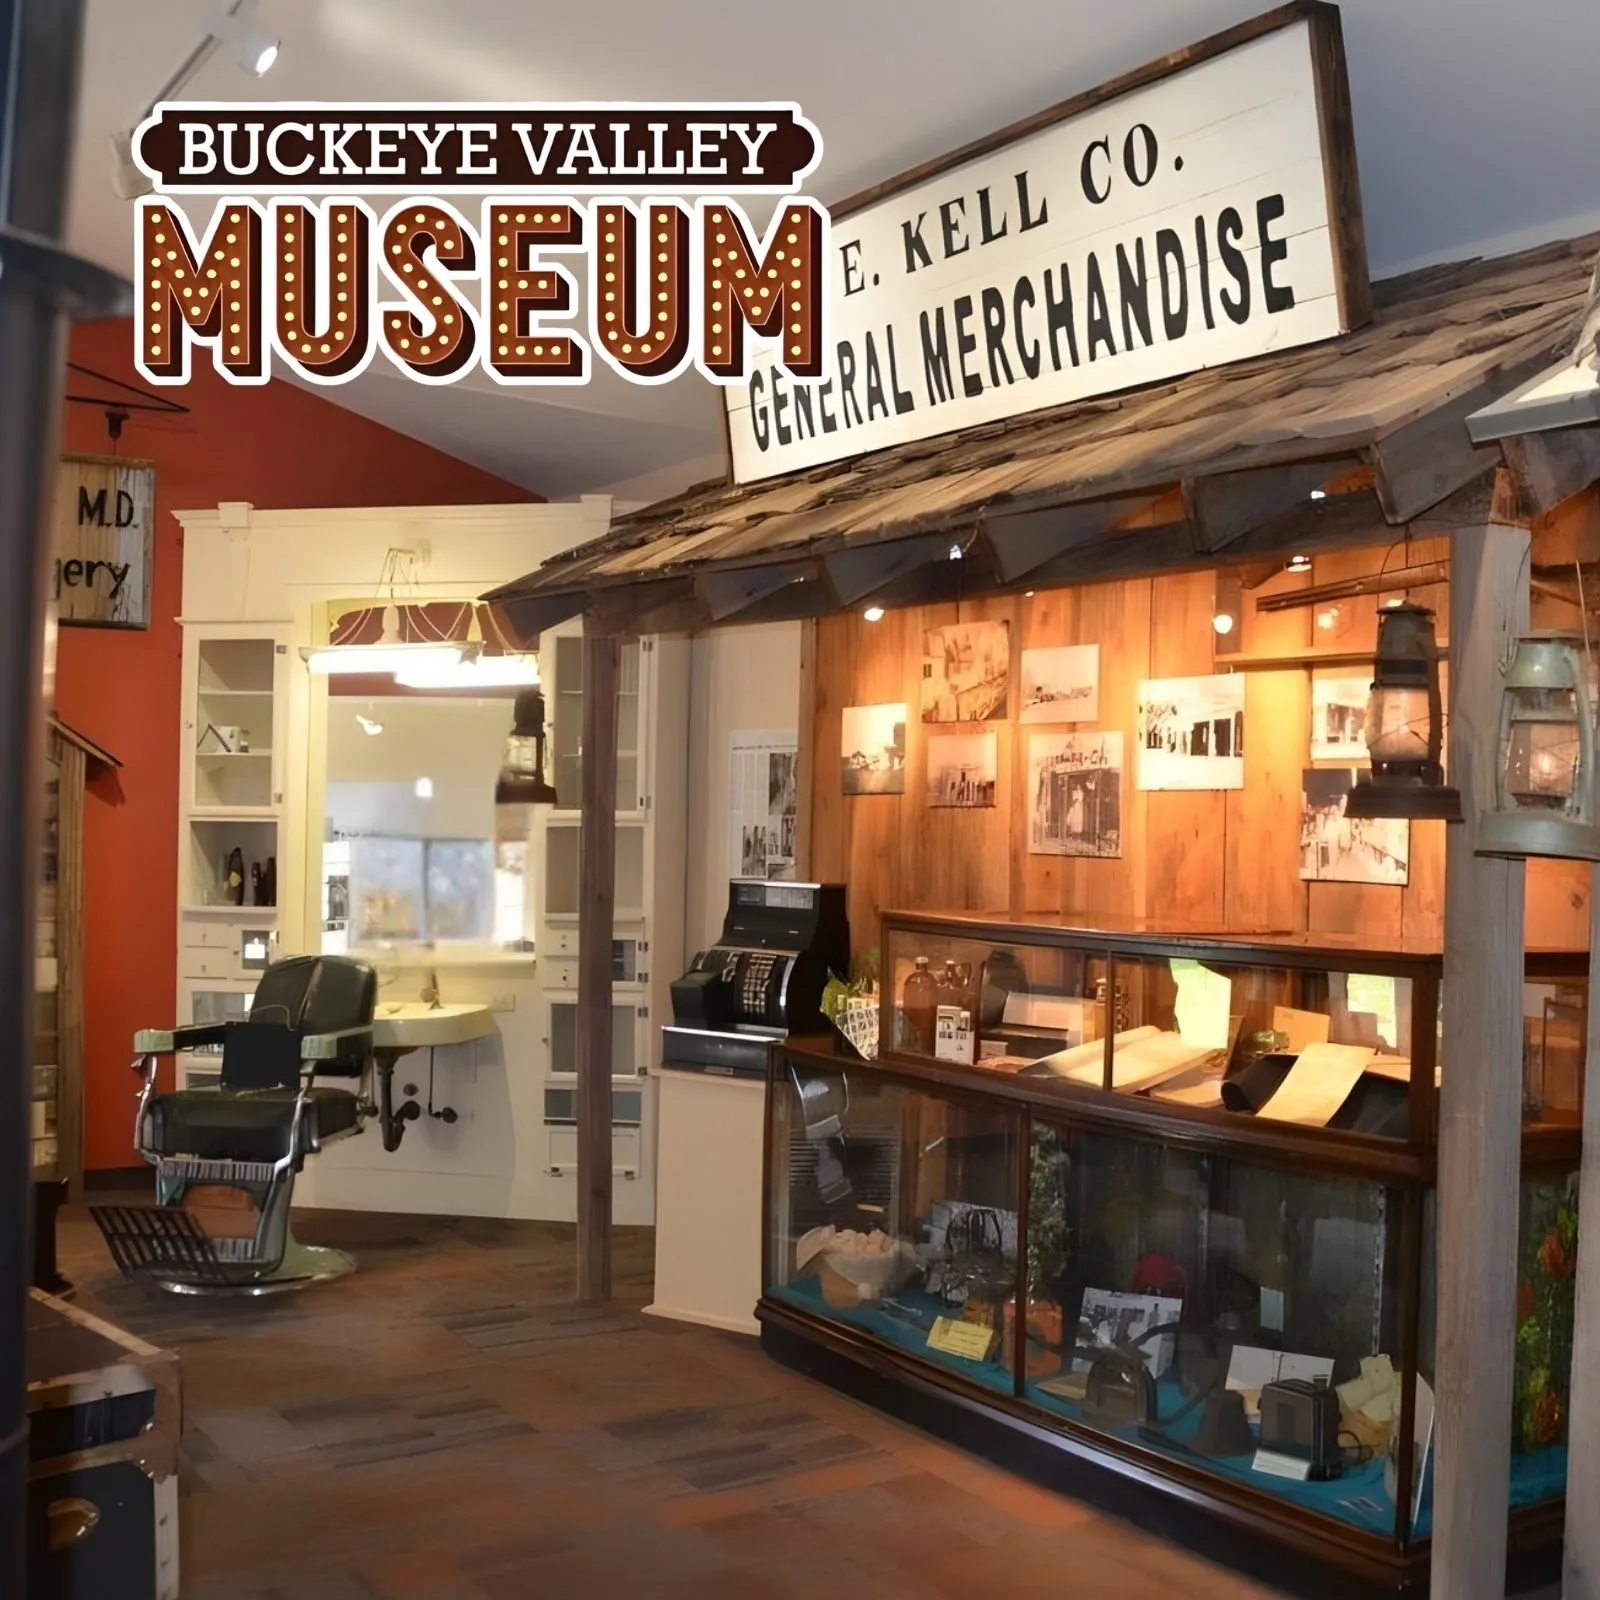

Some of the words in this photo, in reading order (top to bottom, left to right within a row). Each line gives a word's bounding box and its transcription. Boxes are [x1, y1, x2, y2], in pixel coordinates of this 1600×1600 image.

[838, 239, 881, 298] E.
[900, 170, 1049, 274] KELL
[1080, 122, 1184, 205] CO.
[749, 323, 916, 453] GENERAL
[919, 193, 1296, 407] MERCHANDISE
[77, 485, 140, 529] M.D.
